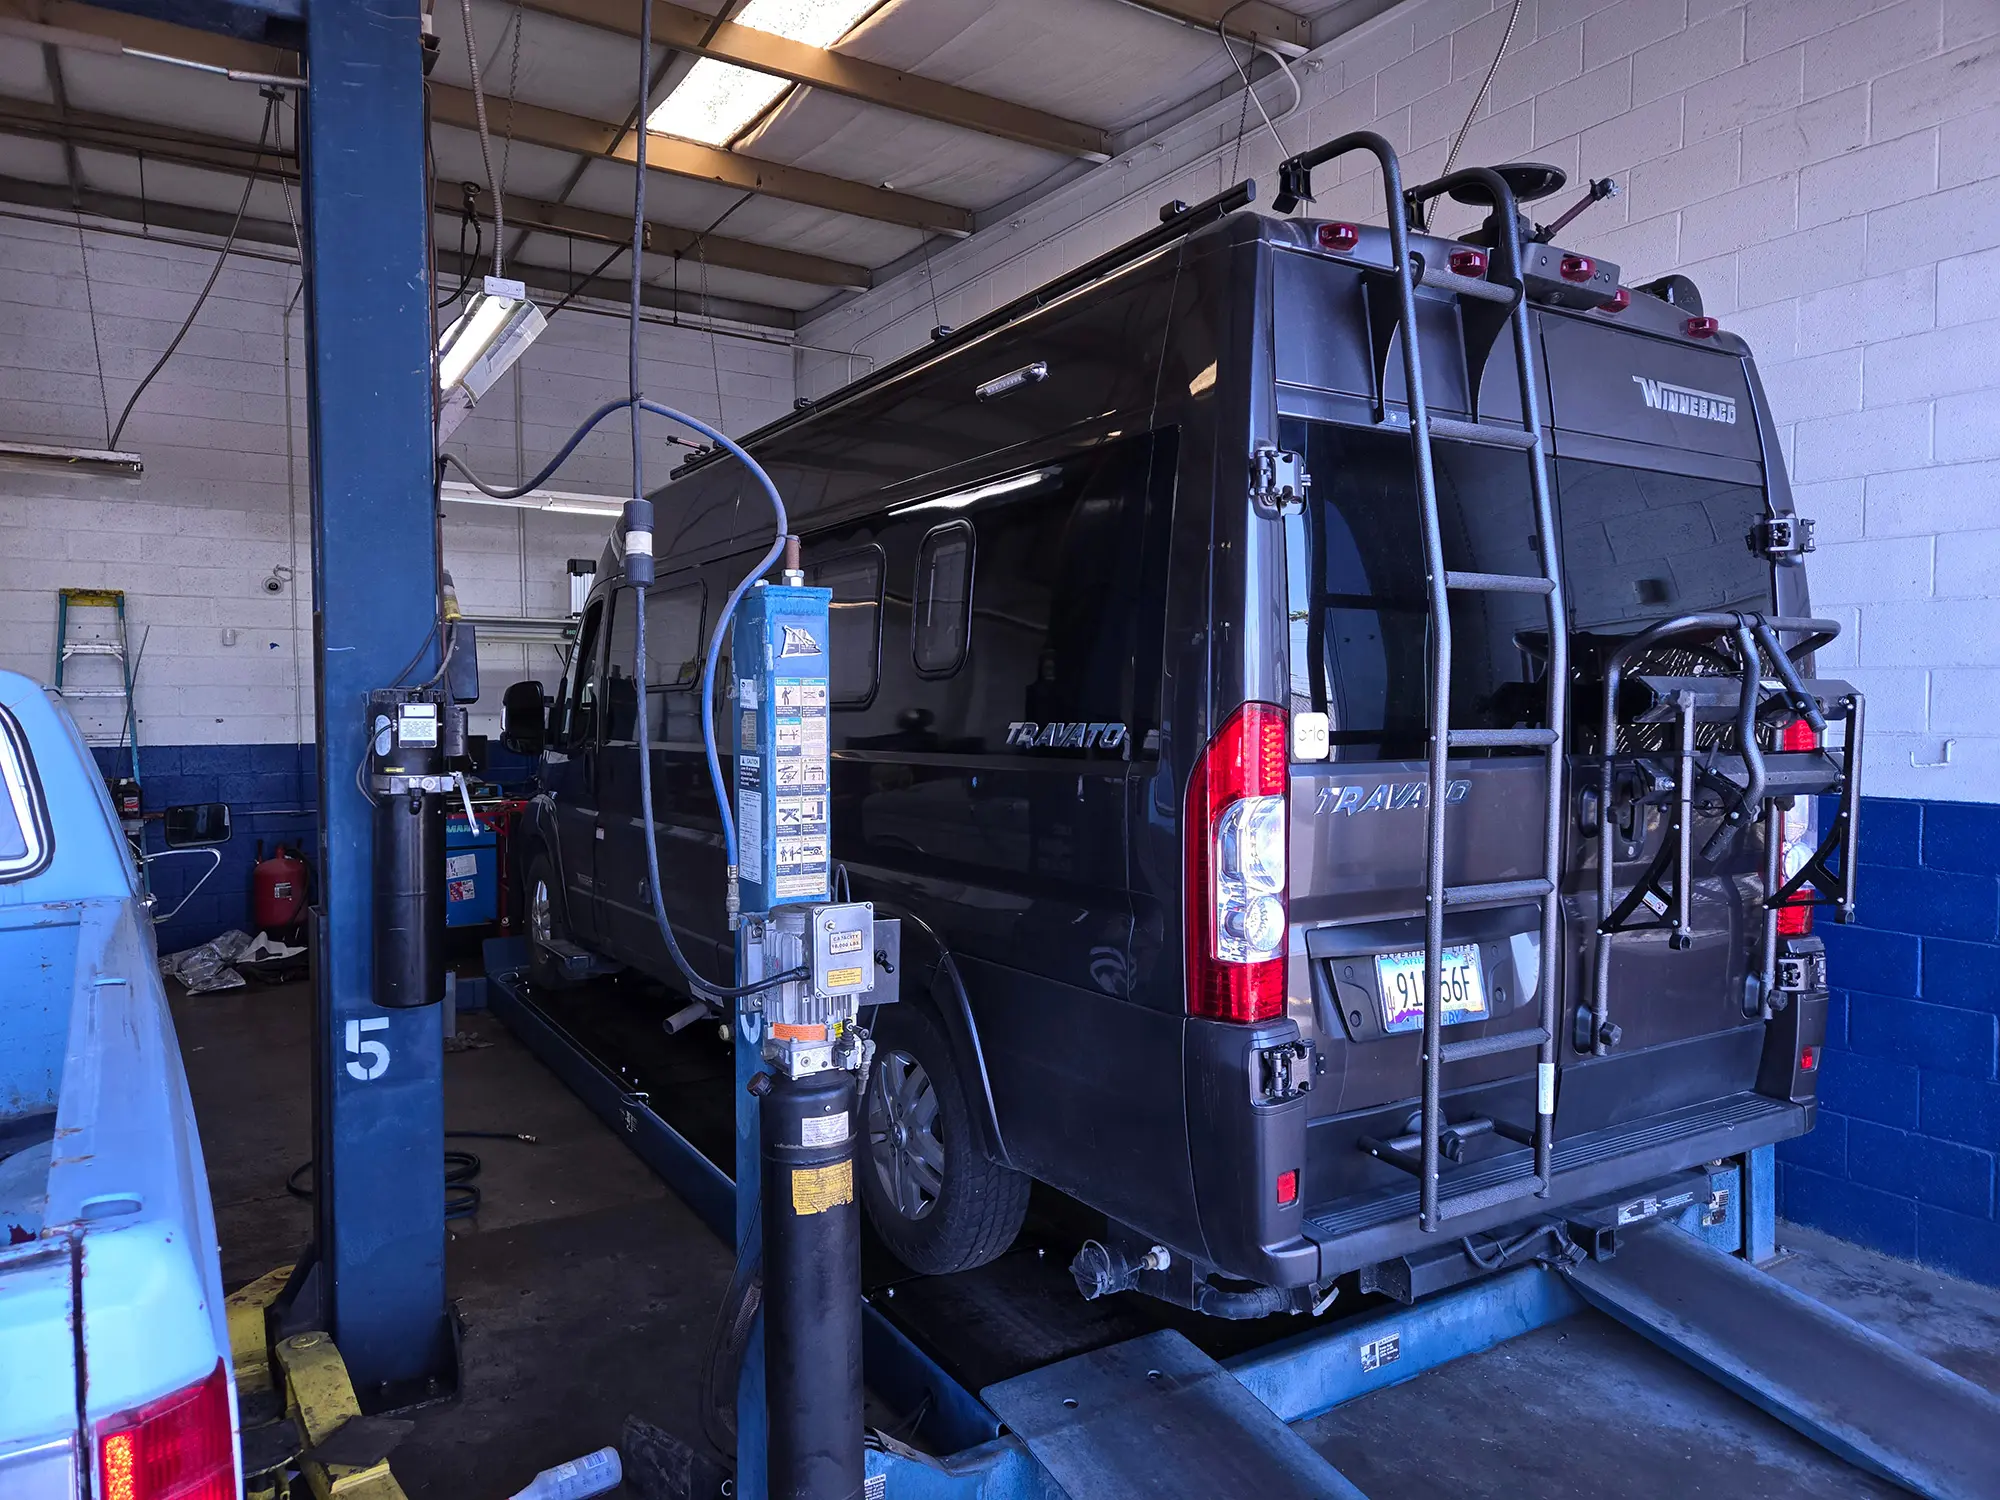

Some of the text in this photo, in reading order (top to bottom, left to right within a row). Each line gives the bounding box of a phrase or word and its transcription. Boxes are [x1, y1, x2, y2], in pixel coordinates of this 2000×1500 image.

[1631, 375, 1736, 425] WINNEBAGO
[1005, 722, 1127, 749] TRAVATO
[1313, 779, 1473, 817] TRAVAO
[345, 1016, 390, 1081] 5
